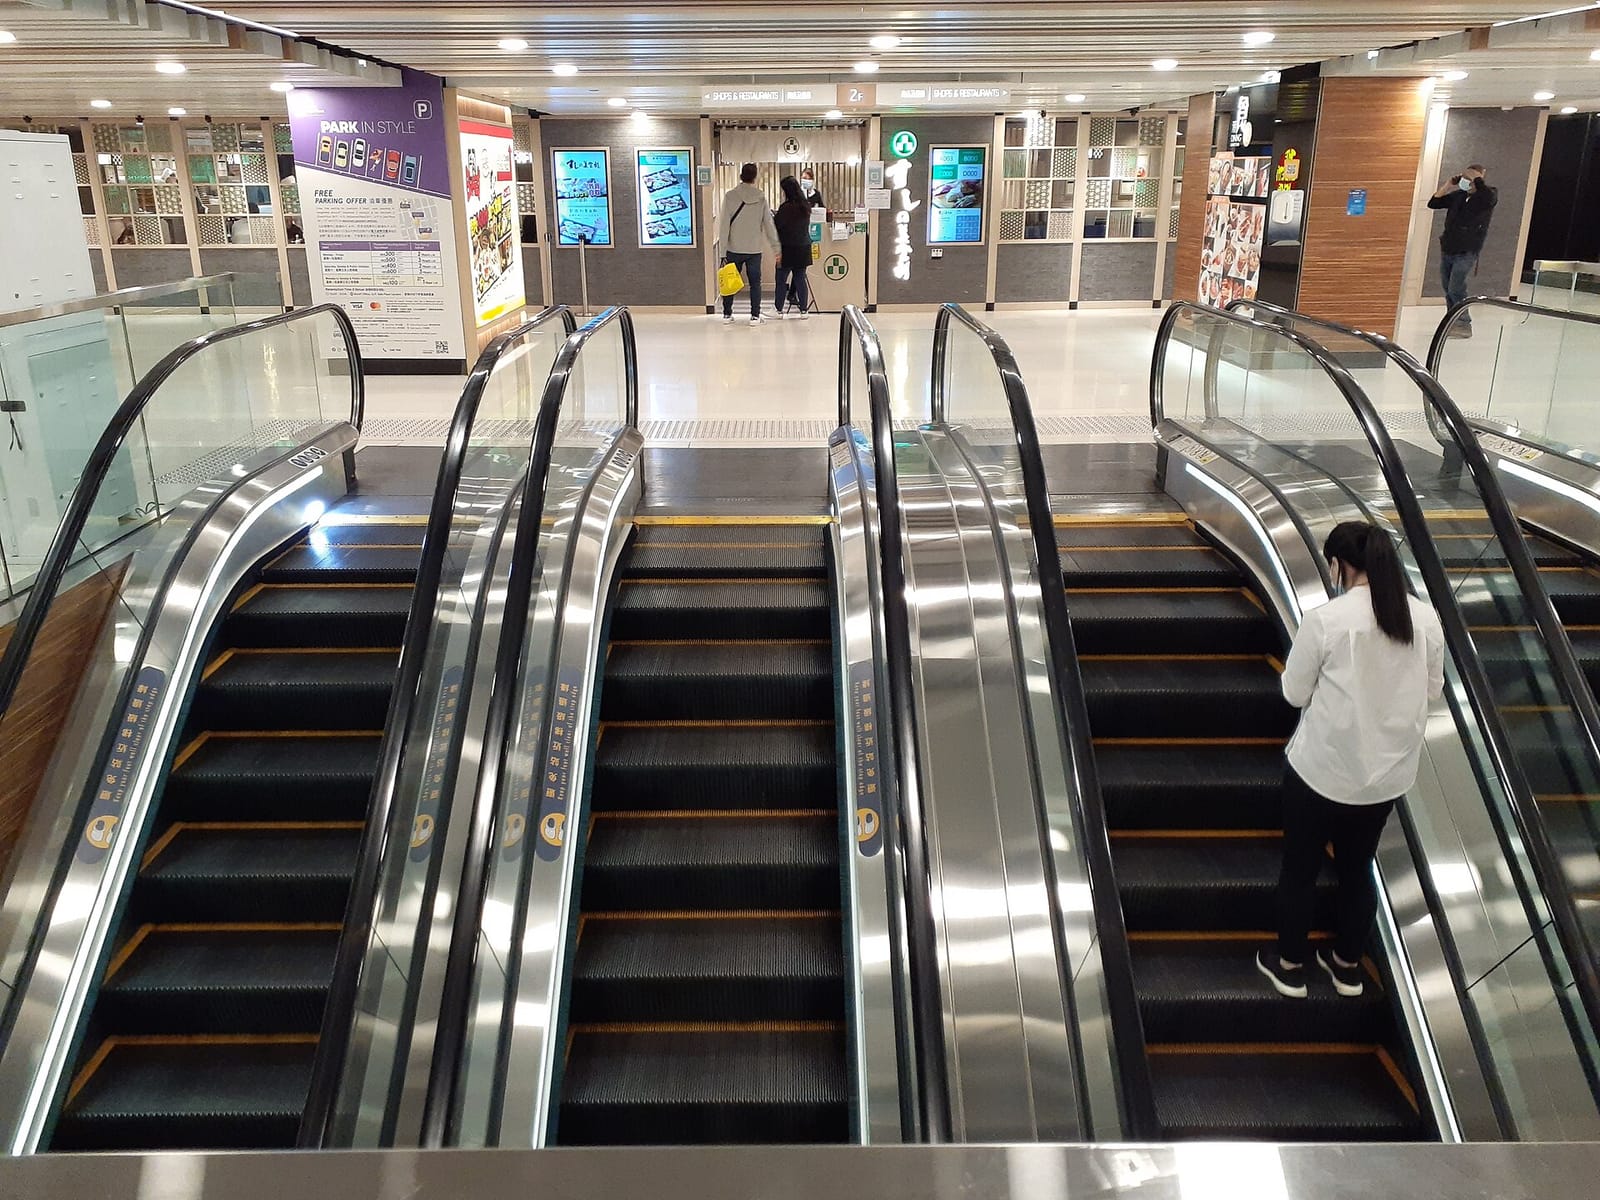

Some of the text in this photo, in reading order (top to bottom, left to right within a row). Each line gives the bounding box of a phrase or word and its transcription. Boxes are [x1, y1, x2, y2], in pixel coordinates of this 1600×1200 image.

[712, 91, 732, 100] SHOPS
[739, 91, 779, 100] RESTAURANTS
[849, 88, 864, 102] 2F
[933, 89, 952, 98] SHOPS
[959, 89, 1000, 98] RESTAURANTS
[417, 103, 428, 117] P
[320, 120, 416, 134] PARK IN STYLE
[314, 189, 333, 197] FREE
